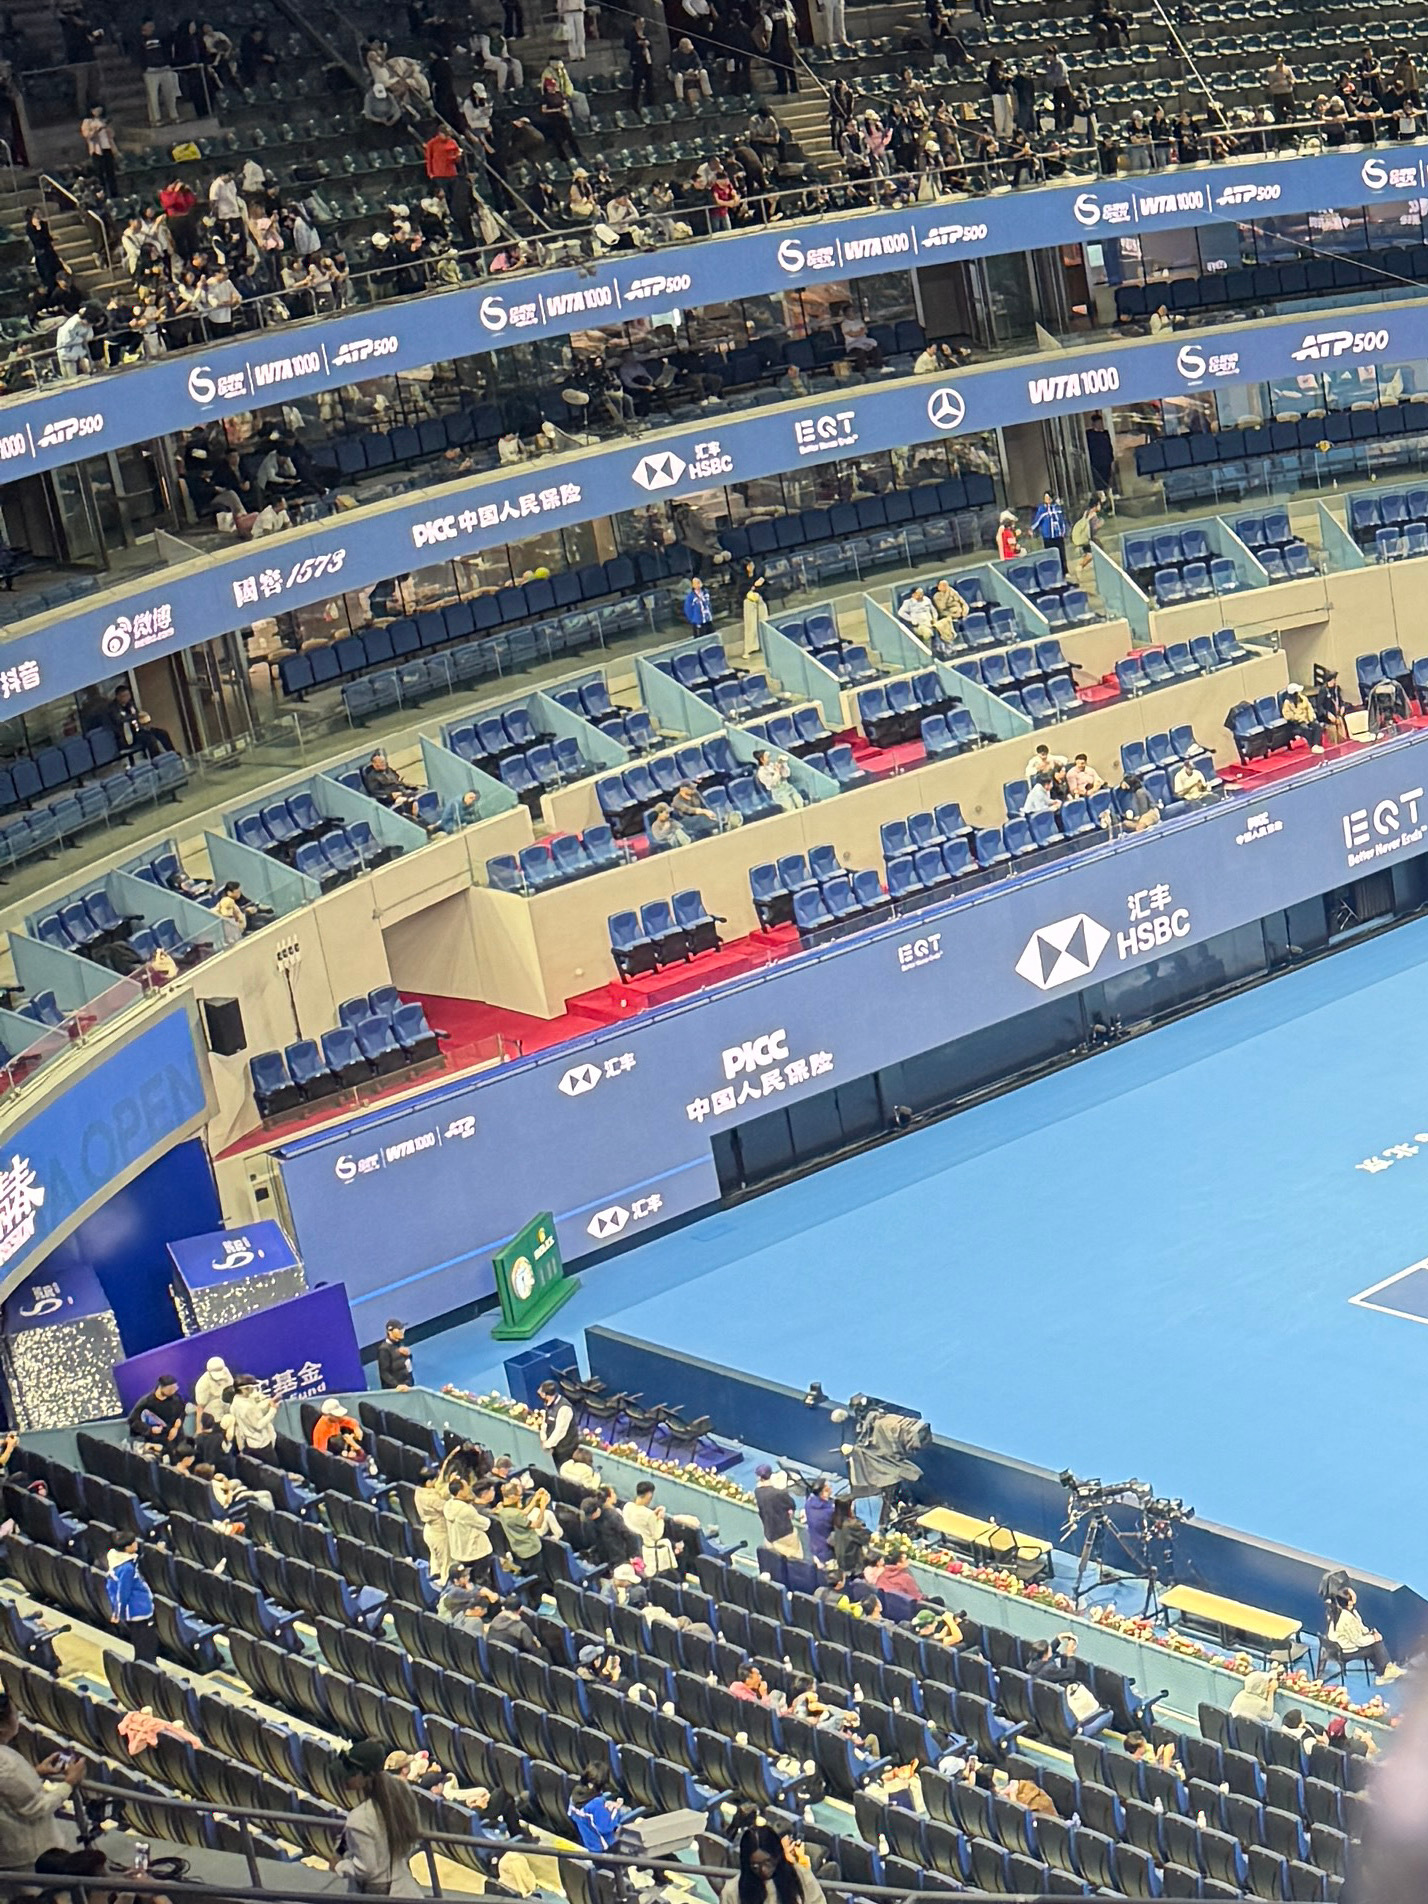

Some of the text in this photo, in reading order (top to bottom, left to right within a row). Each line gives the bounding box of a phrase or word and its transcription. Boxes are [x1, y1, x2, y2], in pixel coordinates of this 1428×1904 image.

[796, 411, 855, 443] EQT
[688, 455, 733, 480] HSBC
[412, 483, 581, 547] PICC 中国人民保险
[1343, 788, 1424, 848] EQT
[1126, 883, 1172, 921] 汇丰
[898, 933, 941, 964] EQT
[1115, 908, 1190, 960] HSBC
[721, 1029, 789, 1079] PICC
[686, 1050, 834, 1123] 中国人民保险
